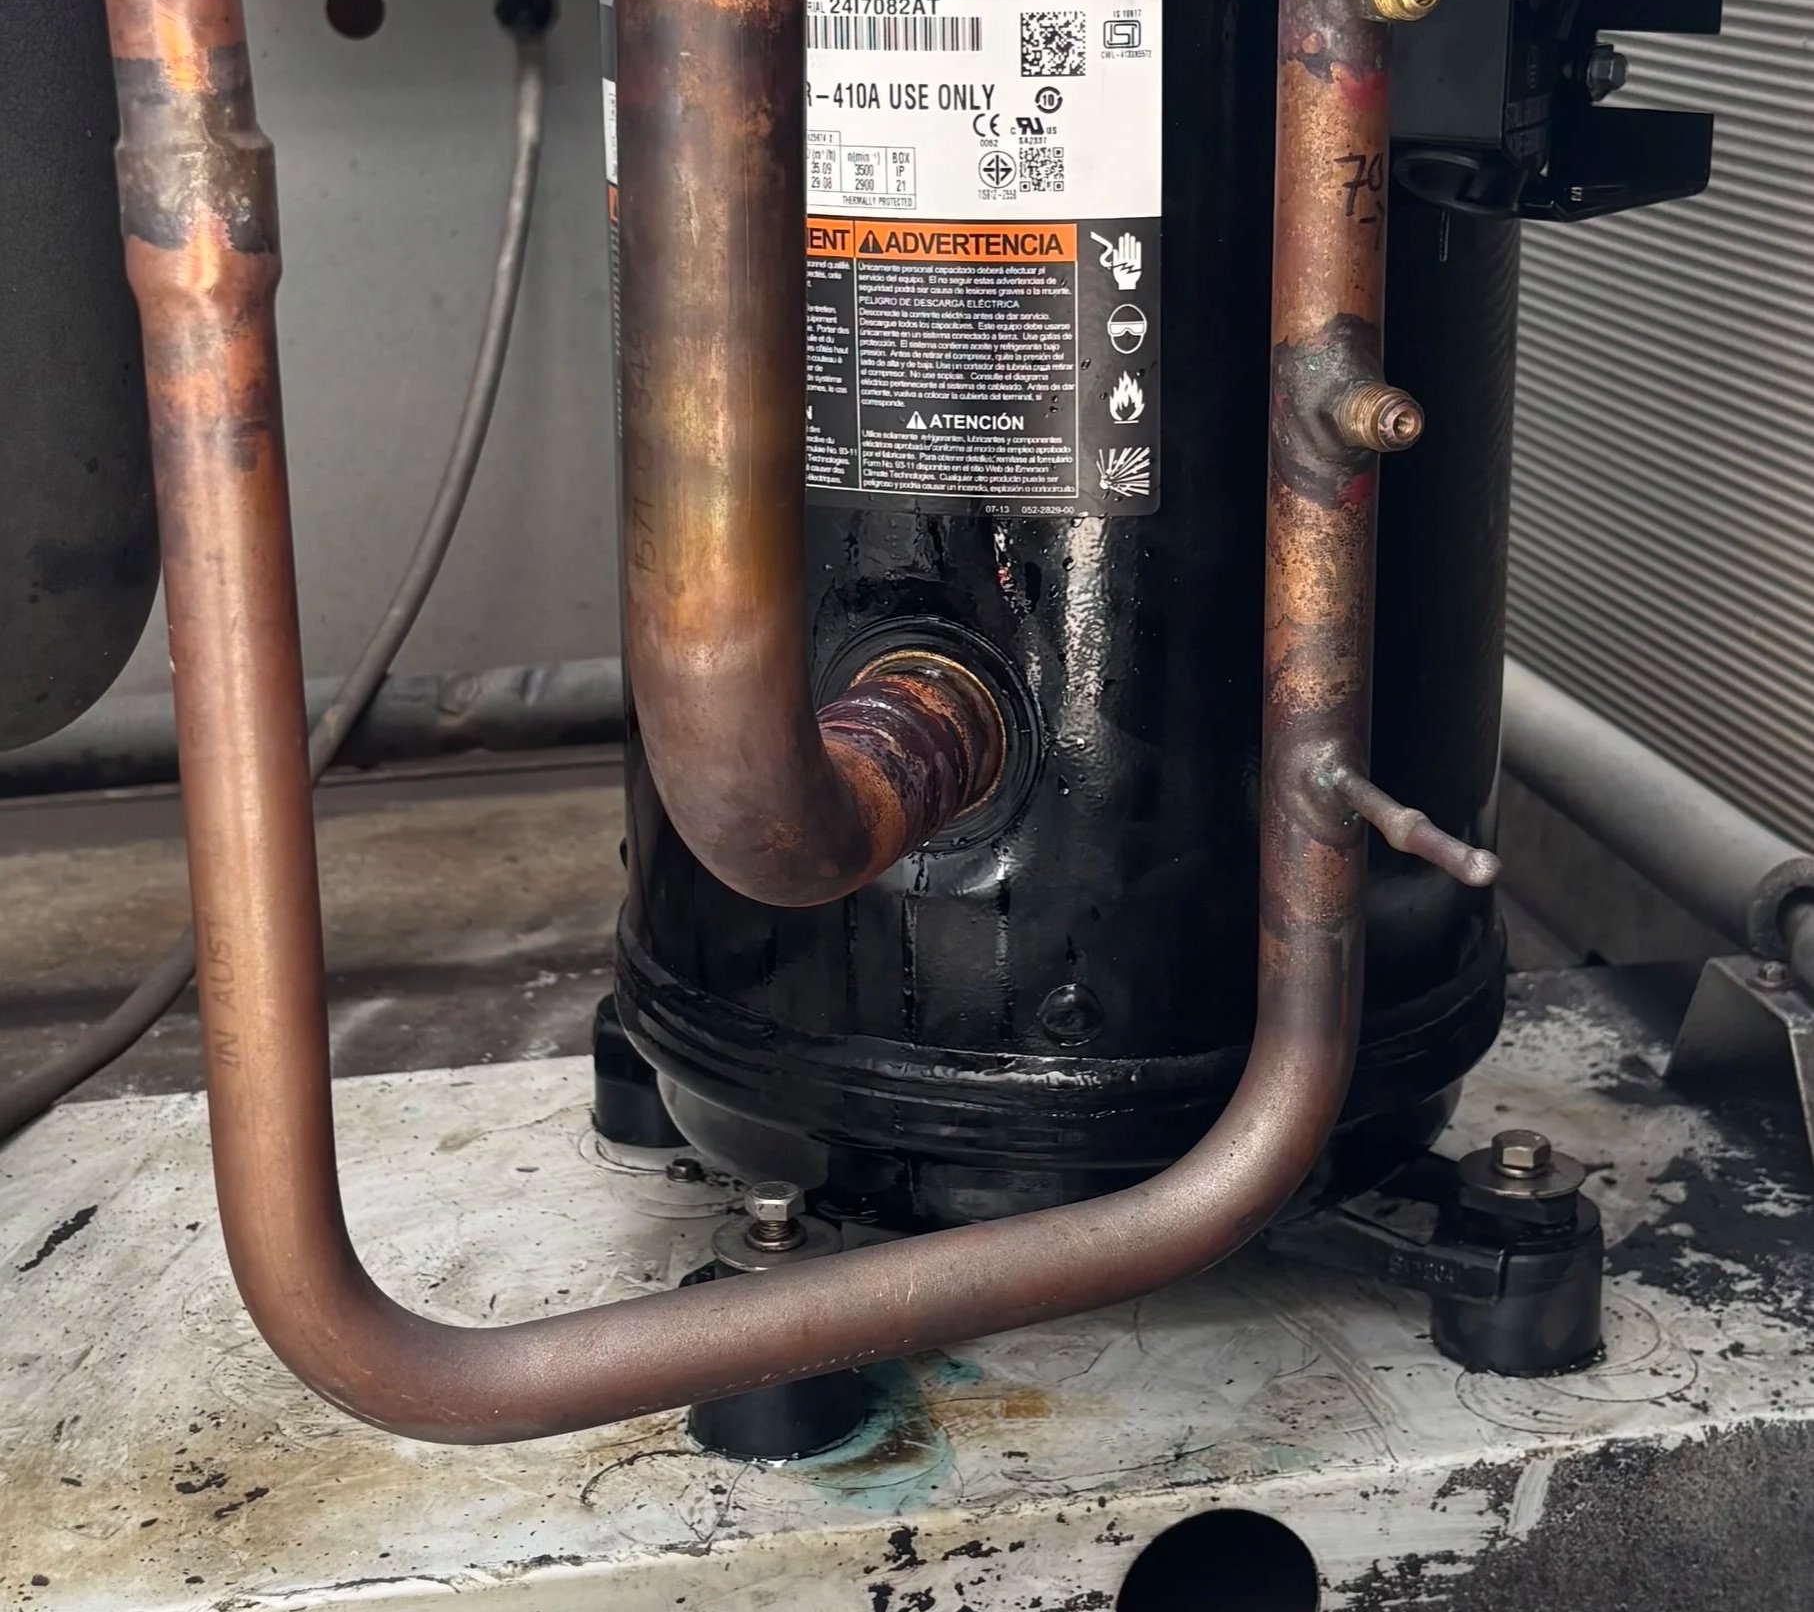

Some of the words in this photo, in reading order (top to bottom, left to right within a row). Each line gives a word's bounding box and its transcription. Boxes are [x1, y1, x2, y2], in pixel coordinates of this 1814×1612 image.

[890, 83, 929, 110] USE
[938, 84, 995, 110] ONLY
[892, 152, 911, 164] BOX
[855, 164, 874, 176] 3500
[896, 166, 905, 177] IP
[855, 179, 874, 190] 2900
[896, 180, 906, 191] 21
[843, 195, 876, 205] THERMALLY
[878, 196, 912, 207] PROTECTED
[807, 228, 850, 250] ENT
[885, 233, 1063, 256] ADVERTENCIA
[859, 296, 897, 306] PELIGRO
[914, 299, 965, 308] DESCARGA
[967, 299, 1020, 308] ELÉCTRICA
[929, 414, 1024, 430] ATENCIÓN
